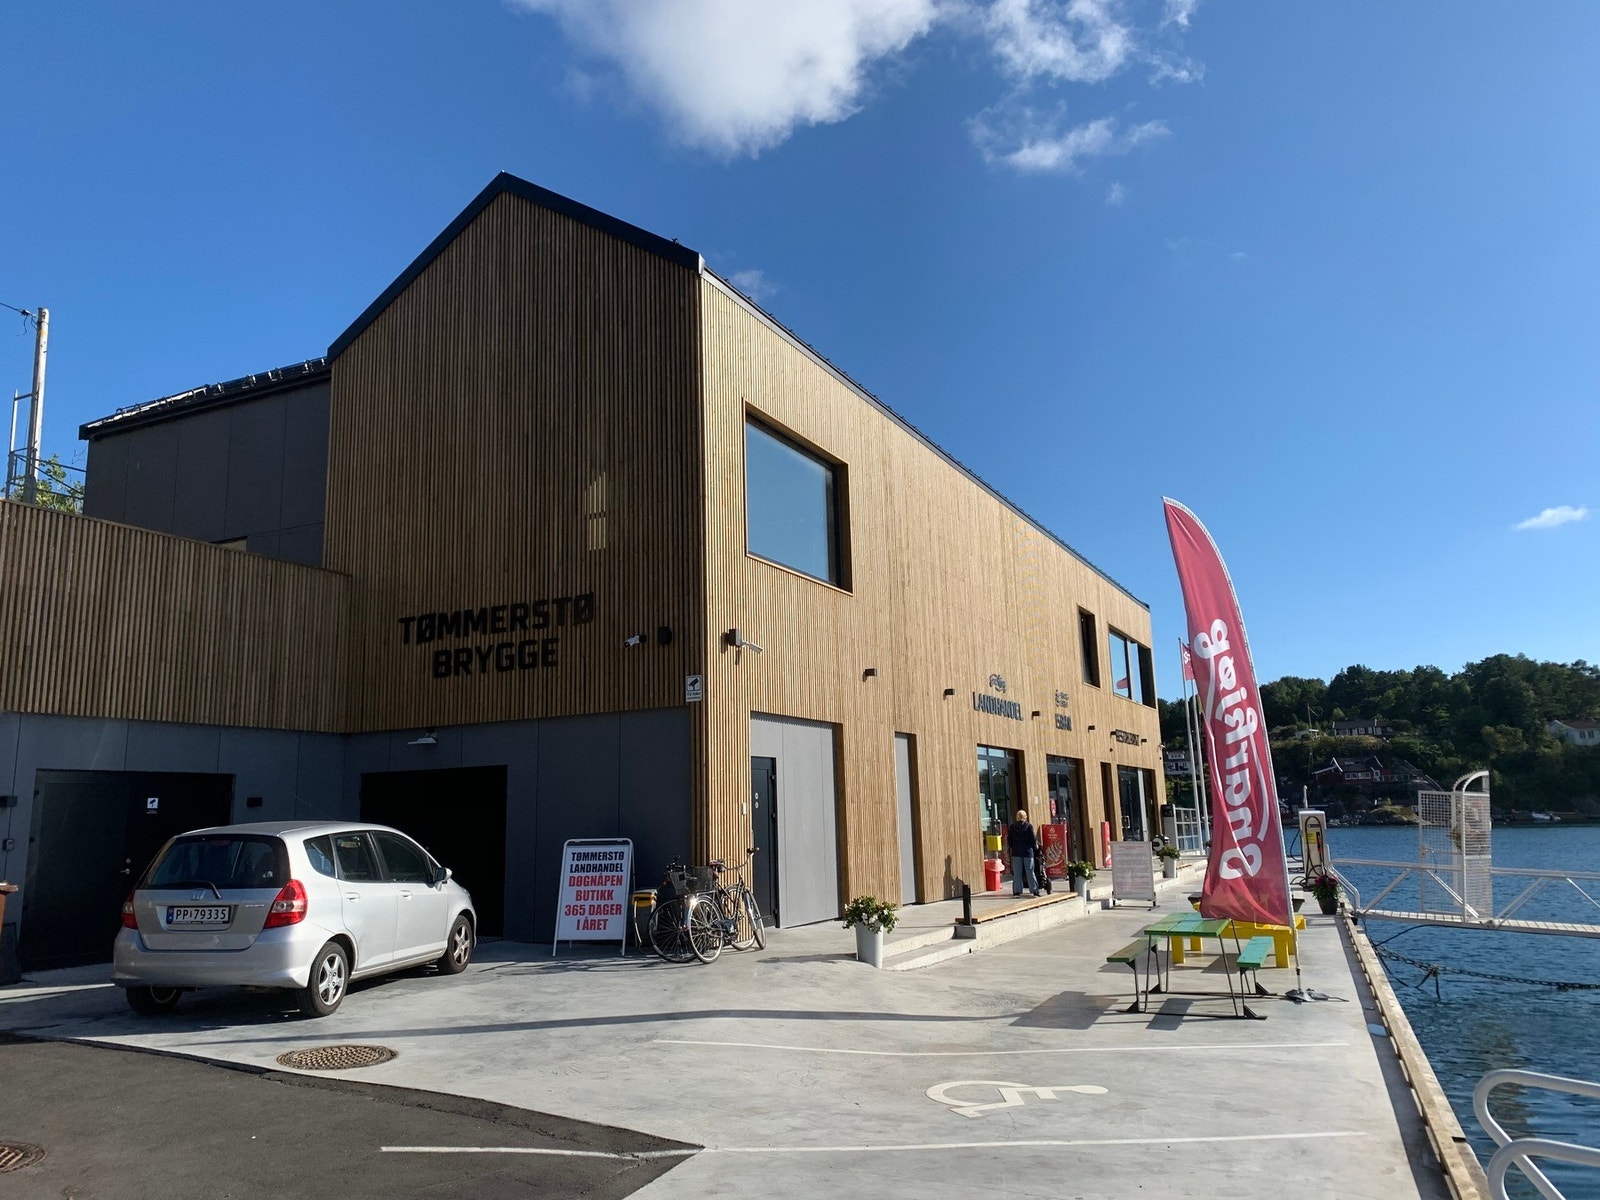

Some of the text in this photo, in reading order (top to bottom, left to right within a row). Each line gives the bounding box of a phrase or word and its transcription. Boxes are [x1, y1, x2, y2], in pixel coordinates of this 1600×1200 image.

[399, 592, 594, 645] TØMMERSTØ
[433, 635, 560, 679] BRYGGE
[972, 691, 1023, 721] LANDHANDEL
[571, 851, 625, 862] TØMMERSTØ
[569, 863, 624, 873] LANDHANDEL
[568, 873, 623, 887] DØGNÅPEN
[575, 889, 614, 901] BUTIKK
[175, 908, 226, 920] PP 79335
[564, 904, 622, 916] 365 DAGER
[576, 916, 608, 931] I ÅRET
